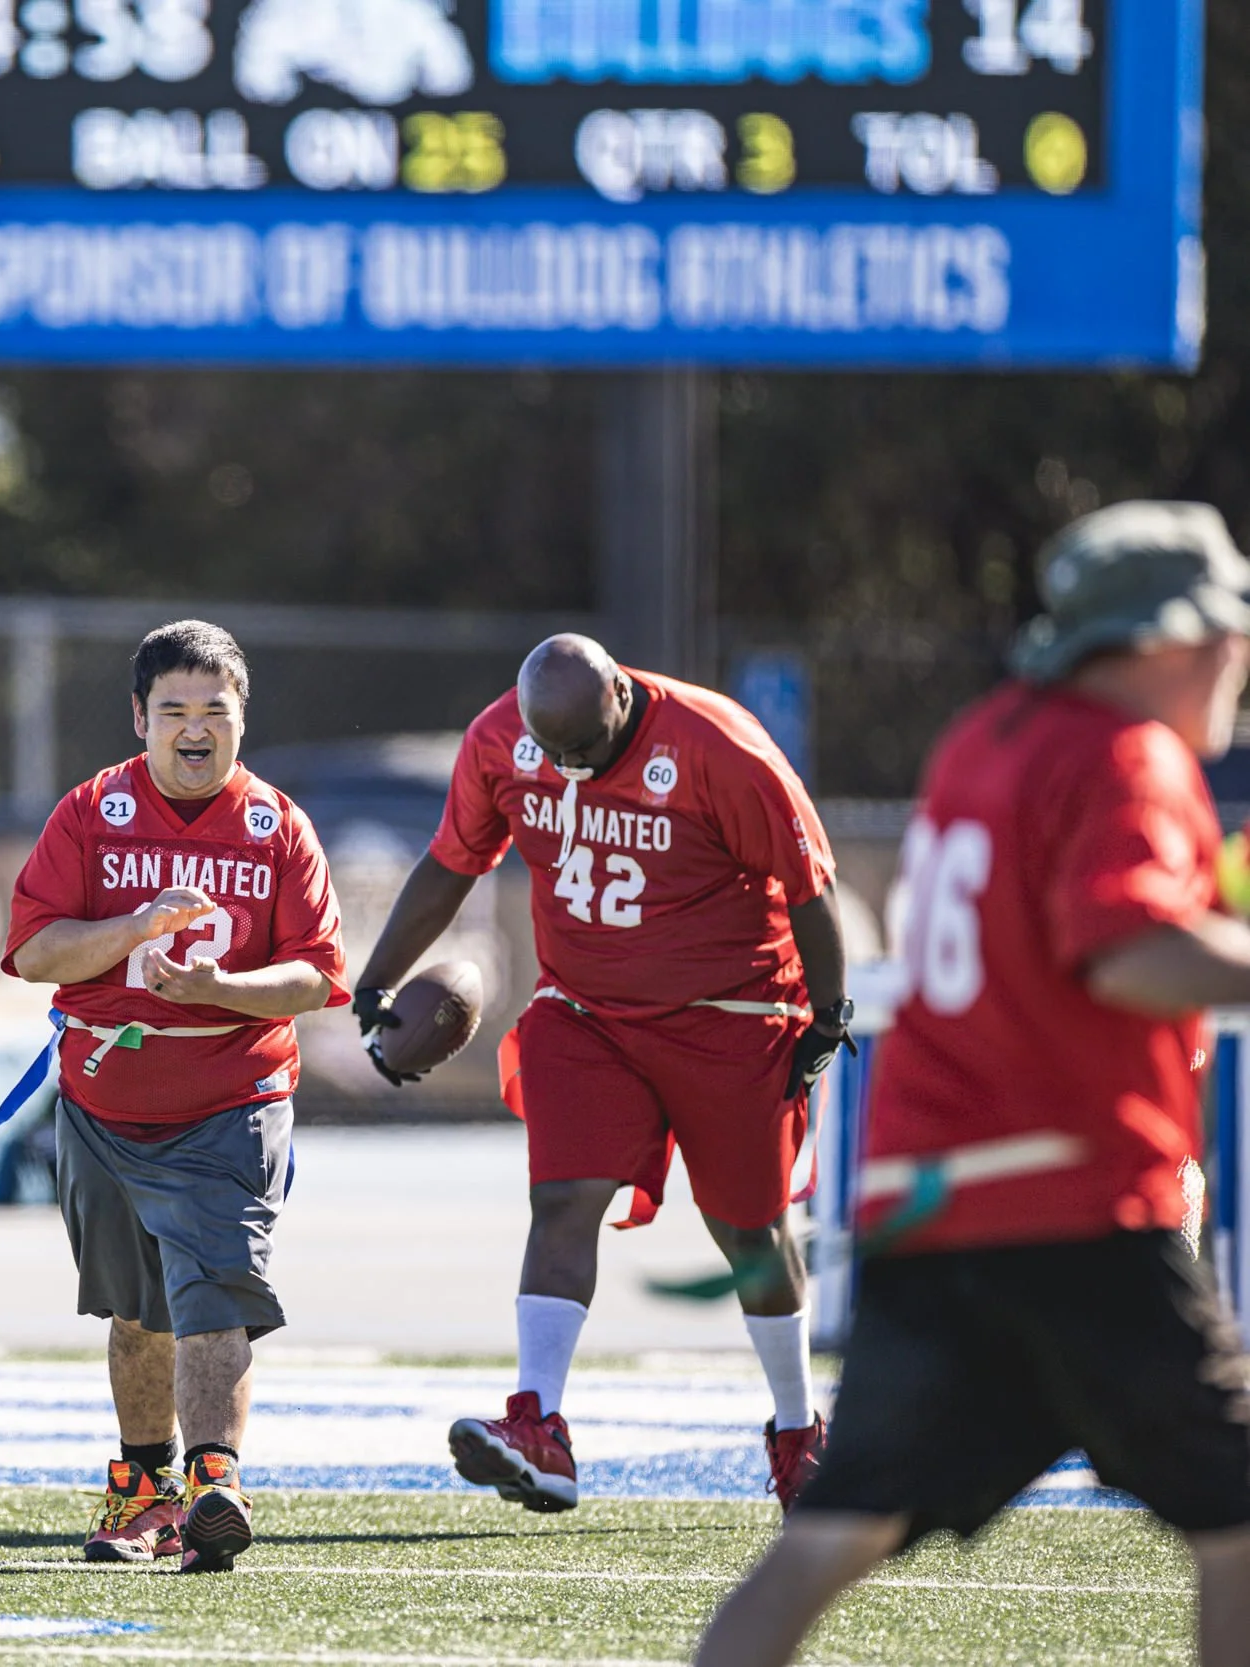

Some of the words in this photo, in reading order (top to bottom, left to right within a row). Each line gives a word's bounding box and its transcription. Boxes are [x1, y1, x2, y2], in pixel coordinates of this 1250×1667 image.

[71, 107, 268, 190] BALL
[284, 107, 400, 191] ON
[575, 107, 727, 203] QTR
[735, 111, 796, 195] 3
[850, 110, 1000, 195] TOL
[264, 221, 351, 329] OF
[360, 222, 661, 331] BULLDOG
[666, 222, 1010, 332] ATHLETICS
[517, 743, 538, 762] 21
[648, 765, 672, 785] 60
[104, 801, 130, 817] 21
[250, 812, 273, 830] 60
[581, 805, 672, 852] MATEO
[102, 853, 161, 889] SAN
[172, 854, 272, 900] MATEO
[554, 844, 646, 928] 42
